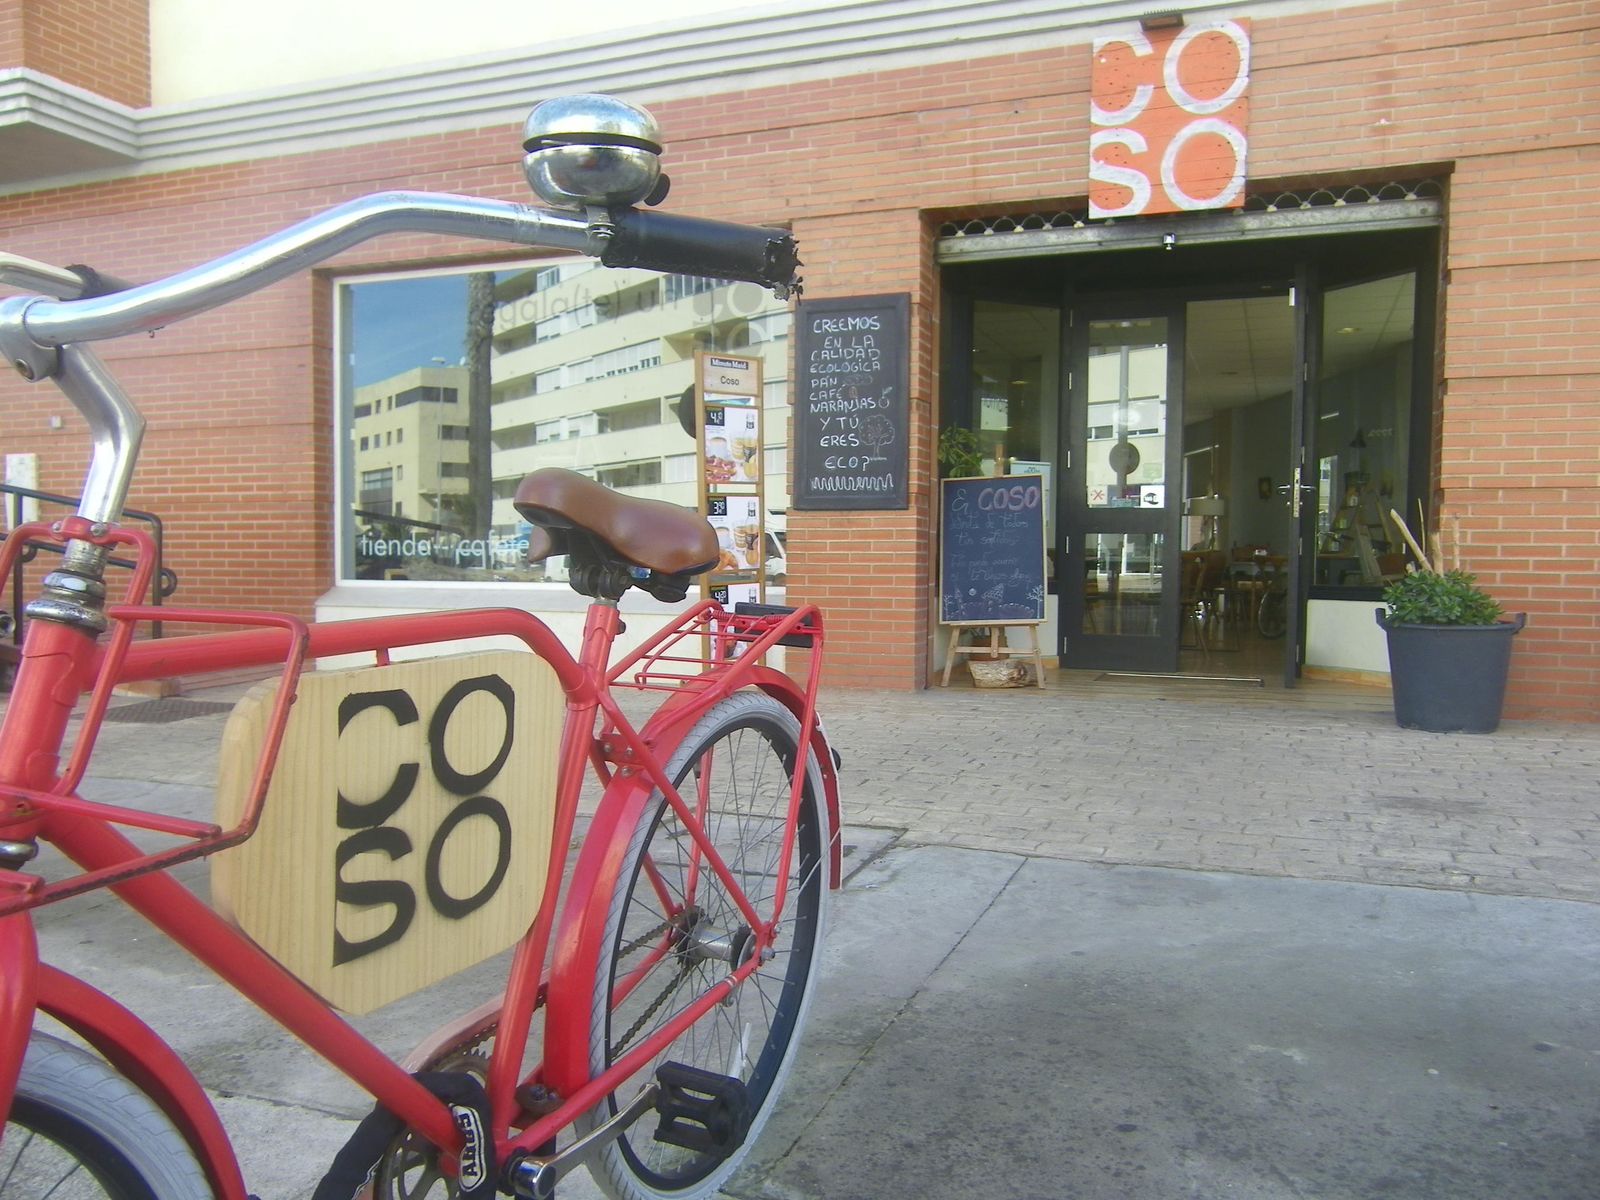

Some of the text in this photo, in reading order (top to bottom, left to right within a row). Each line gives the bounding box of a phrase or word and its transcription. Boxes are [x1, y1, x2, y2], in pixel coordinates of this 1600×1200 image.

[813, 316, 881, 333] CREEMOS
[824, 335, 874, 349] EN LA
[811, 348, 881, 361] CALIDAD
[720, 375, 740, 386] Coso
[810, 397, 877, 413] NARANJAS
[820, 416, 831, 431] Y
[820, 433, 860, 447] ERES
[824, 455, 870, 472] ECO?
[977, 486, 1040, 511] COSO
[360, 531, 431, 557] tienda
